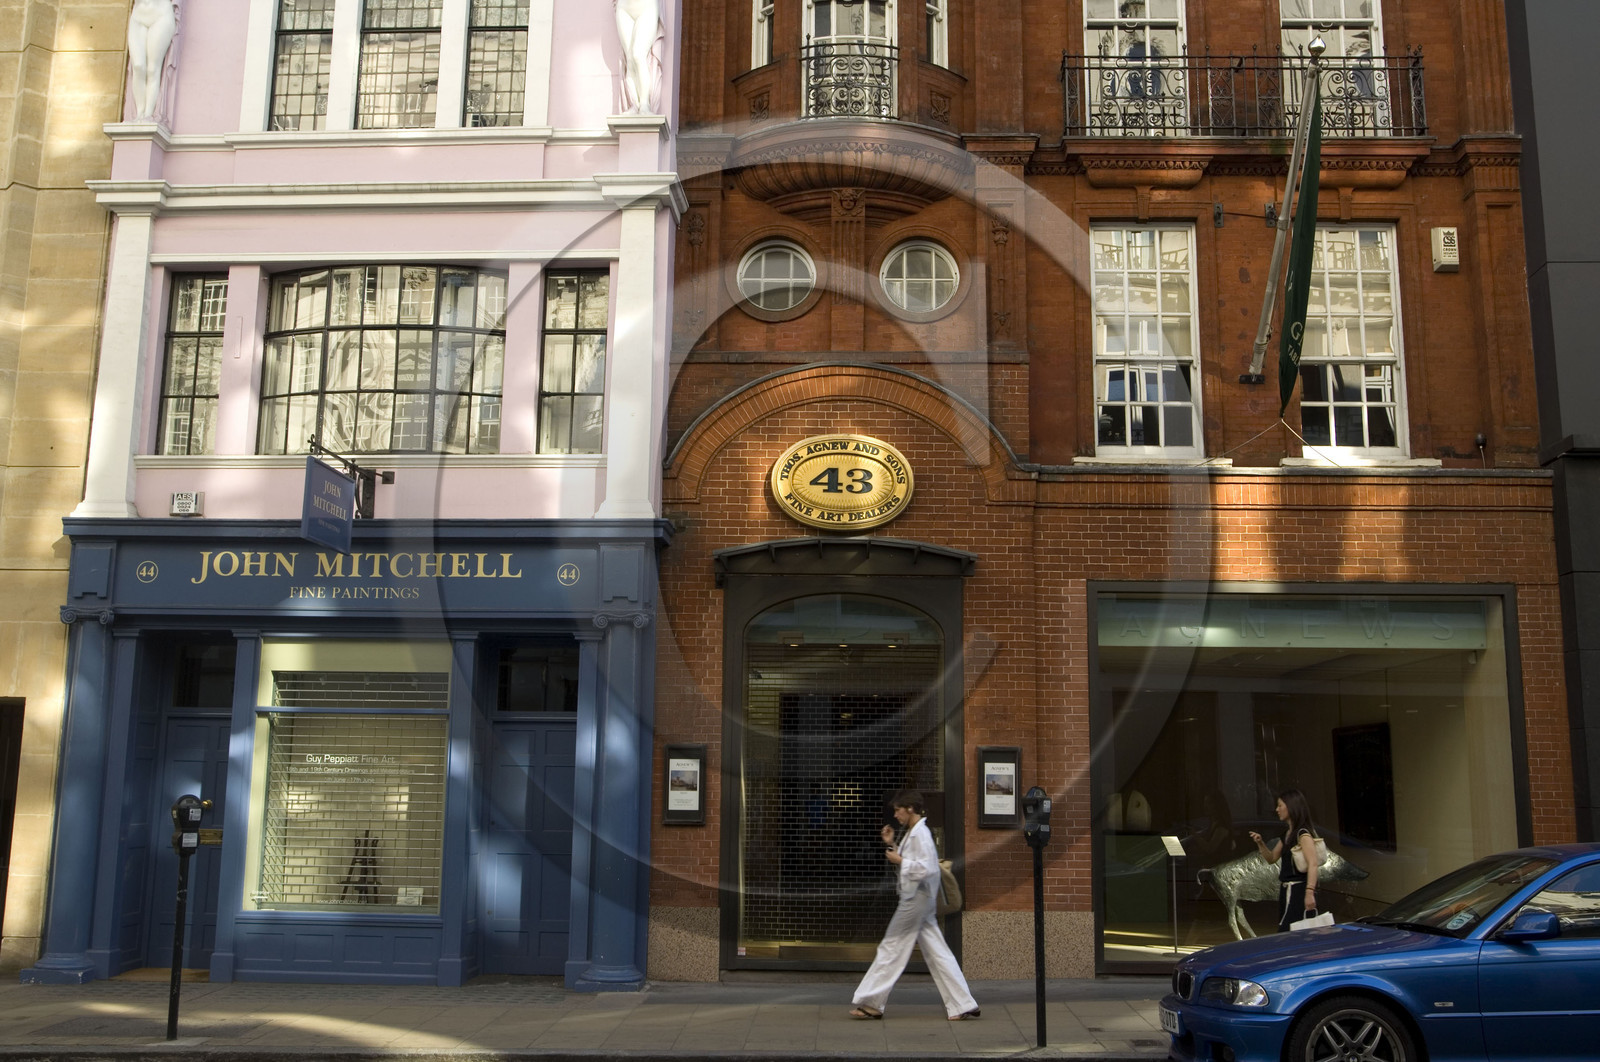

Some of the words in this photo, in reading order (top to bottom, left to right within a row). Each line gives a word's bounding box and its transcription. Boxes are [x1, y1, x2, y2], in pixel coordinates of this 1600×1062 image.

[780, 452, 804, 481] THOS.
[806, 441, 850, 456] AGNEW
[852, 442, 880, 456] AND
[884, 454, 906, 485] SONS
[323, 480, 342, 498] JOHN
[809, 467, 874, 494] 43
[313, 494, 348, 521] MITCHELL
[784, 492, 814, 517] FINE
[816, 510, 845, 522] ART
[848, 494, 901, 522] DEALERS
[139, 565, 155, 577] 44
[191, 551, 299, 584] JOHN
[314, 552, 522, 578] MITCHELL
[560, 568, 576, 580] 44
[289, 586, 326, 599] FINE
[332, 586, 420, 599] PAINTINGS
[306, 754, 322, 764] Guy
[323, 754, 359, 764] Peppiatt
[361, 755, 379, 764] Fine
[381, 755, 396, 764] Art
